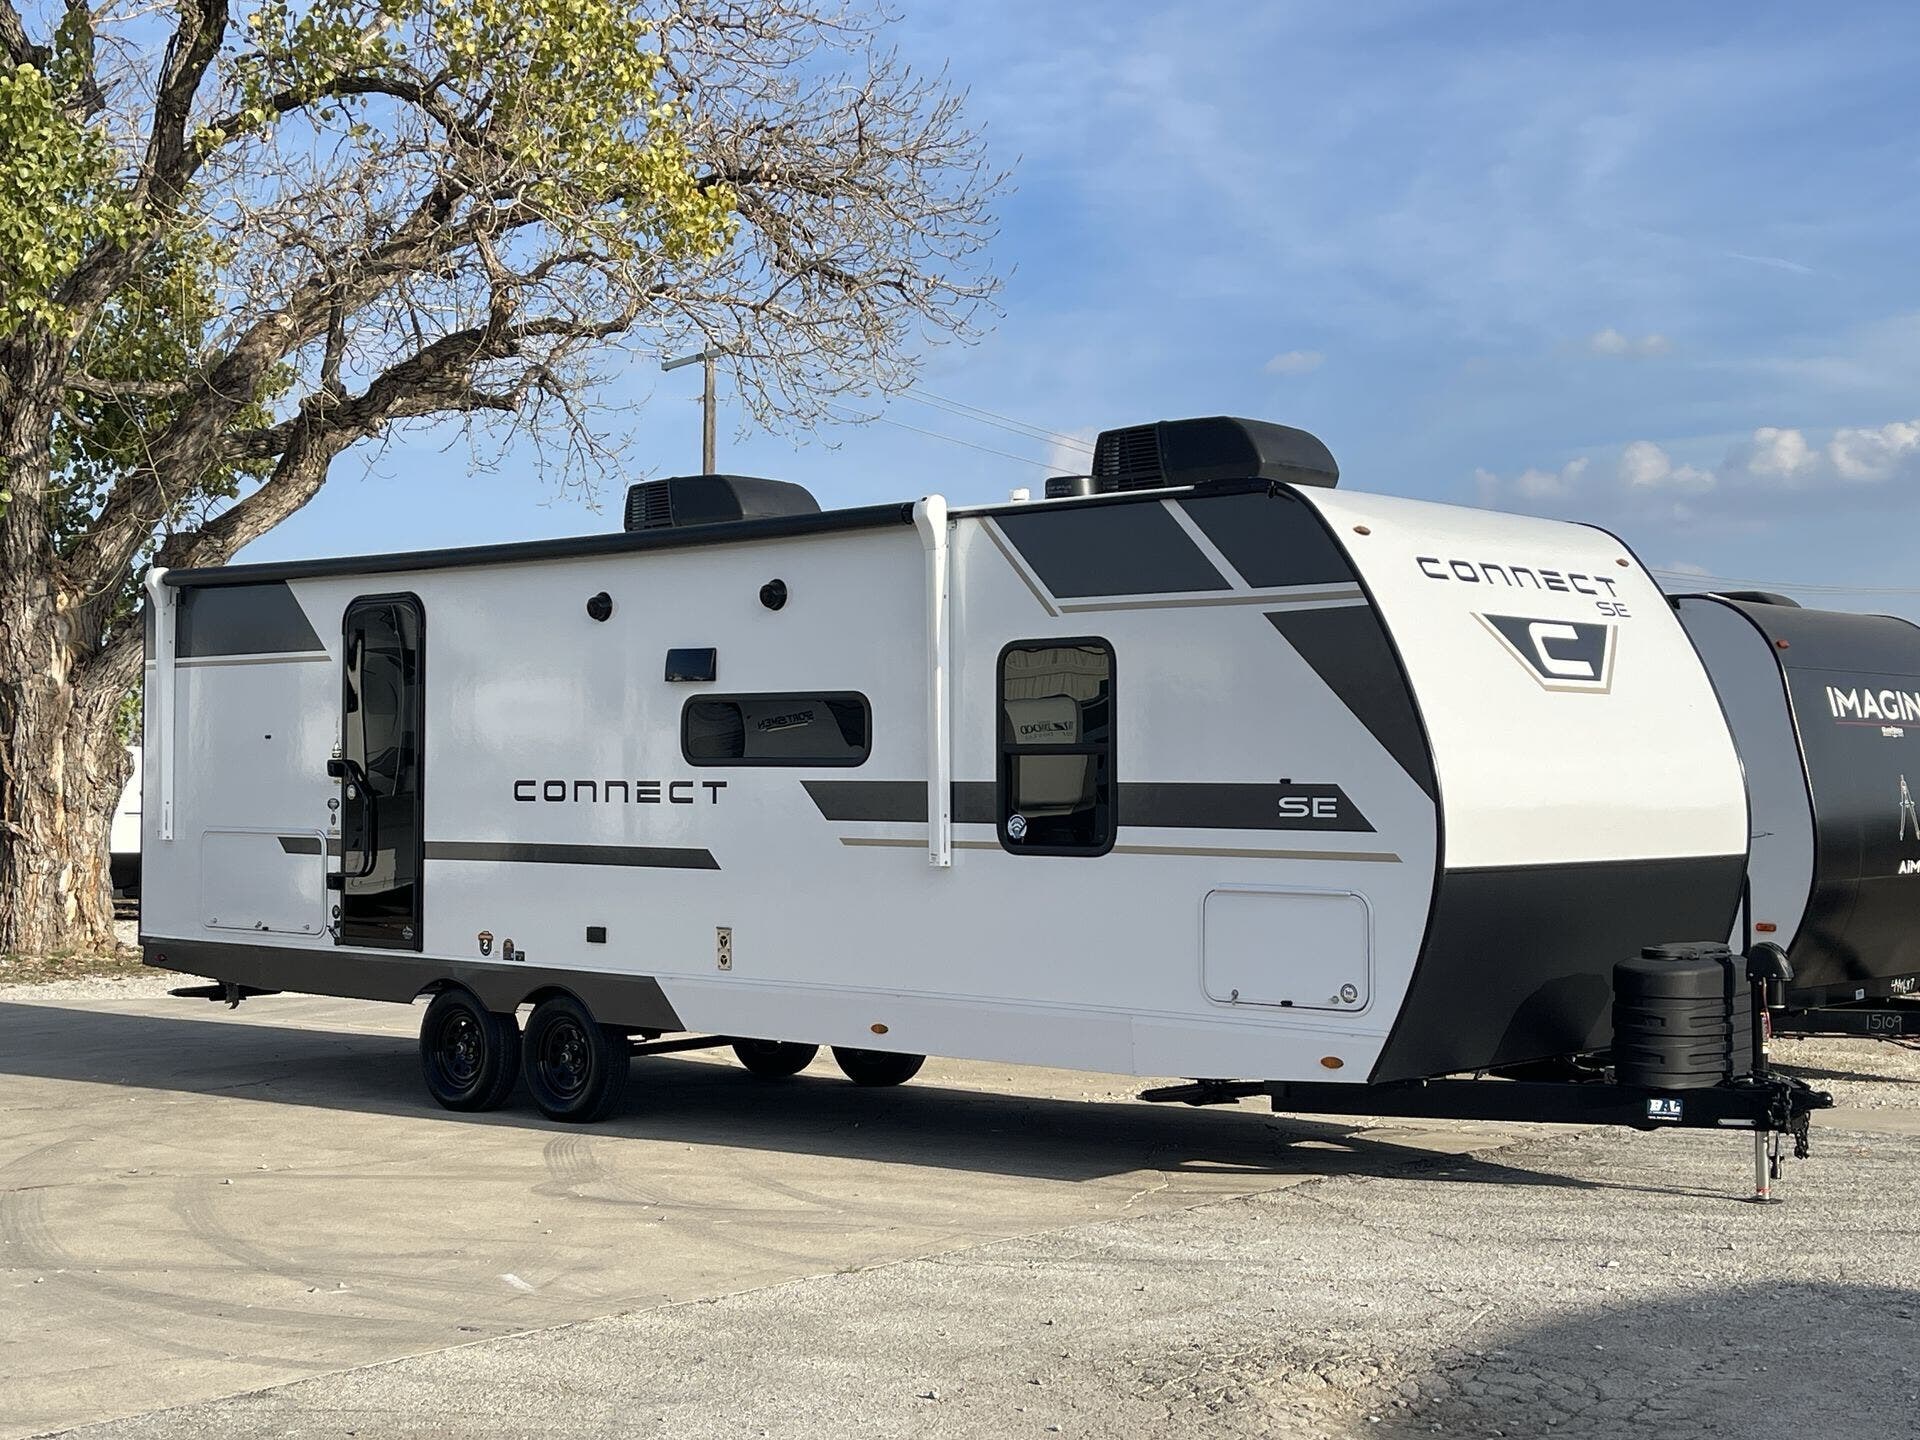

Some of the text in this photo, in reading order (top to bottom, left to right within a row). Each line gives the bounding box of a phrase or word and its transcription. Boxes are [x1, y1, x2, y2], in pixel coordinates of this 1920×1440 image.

[1415, 556, 1618, 597] CONNECT
[1596, 601, 1631, 618] SE
[518, 780, 728, 804] CONNECT
[1278, 796, 1338, 818] SE
[1866, 1013, 1903, 1032] 15109
